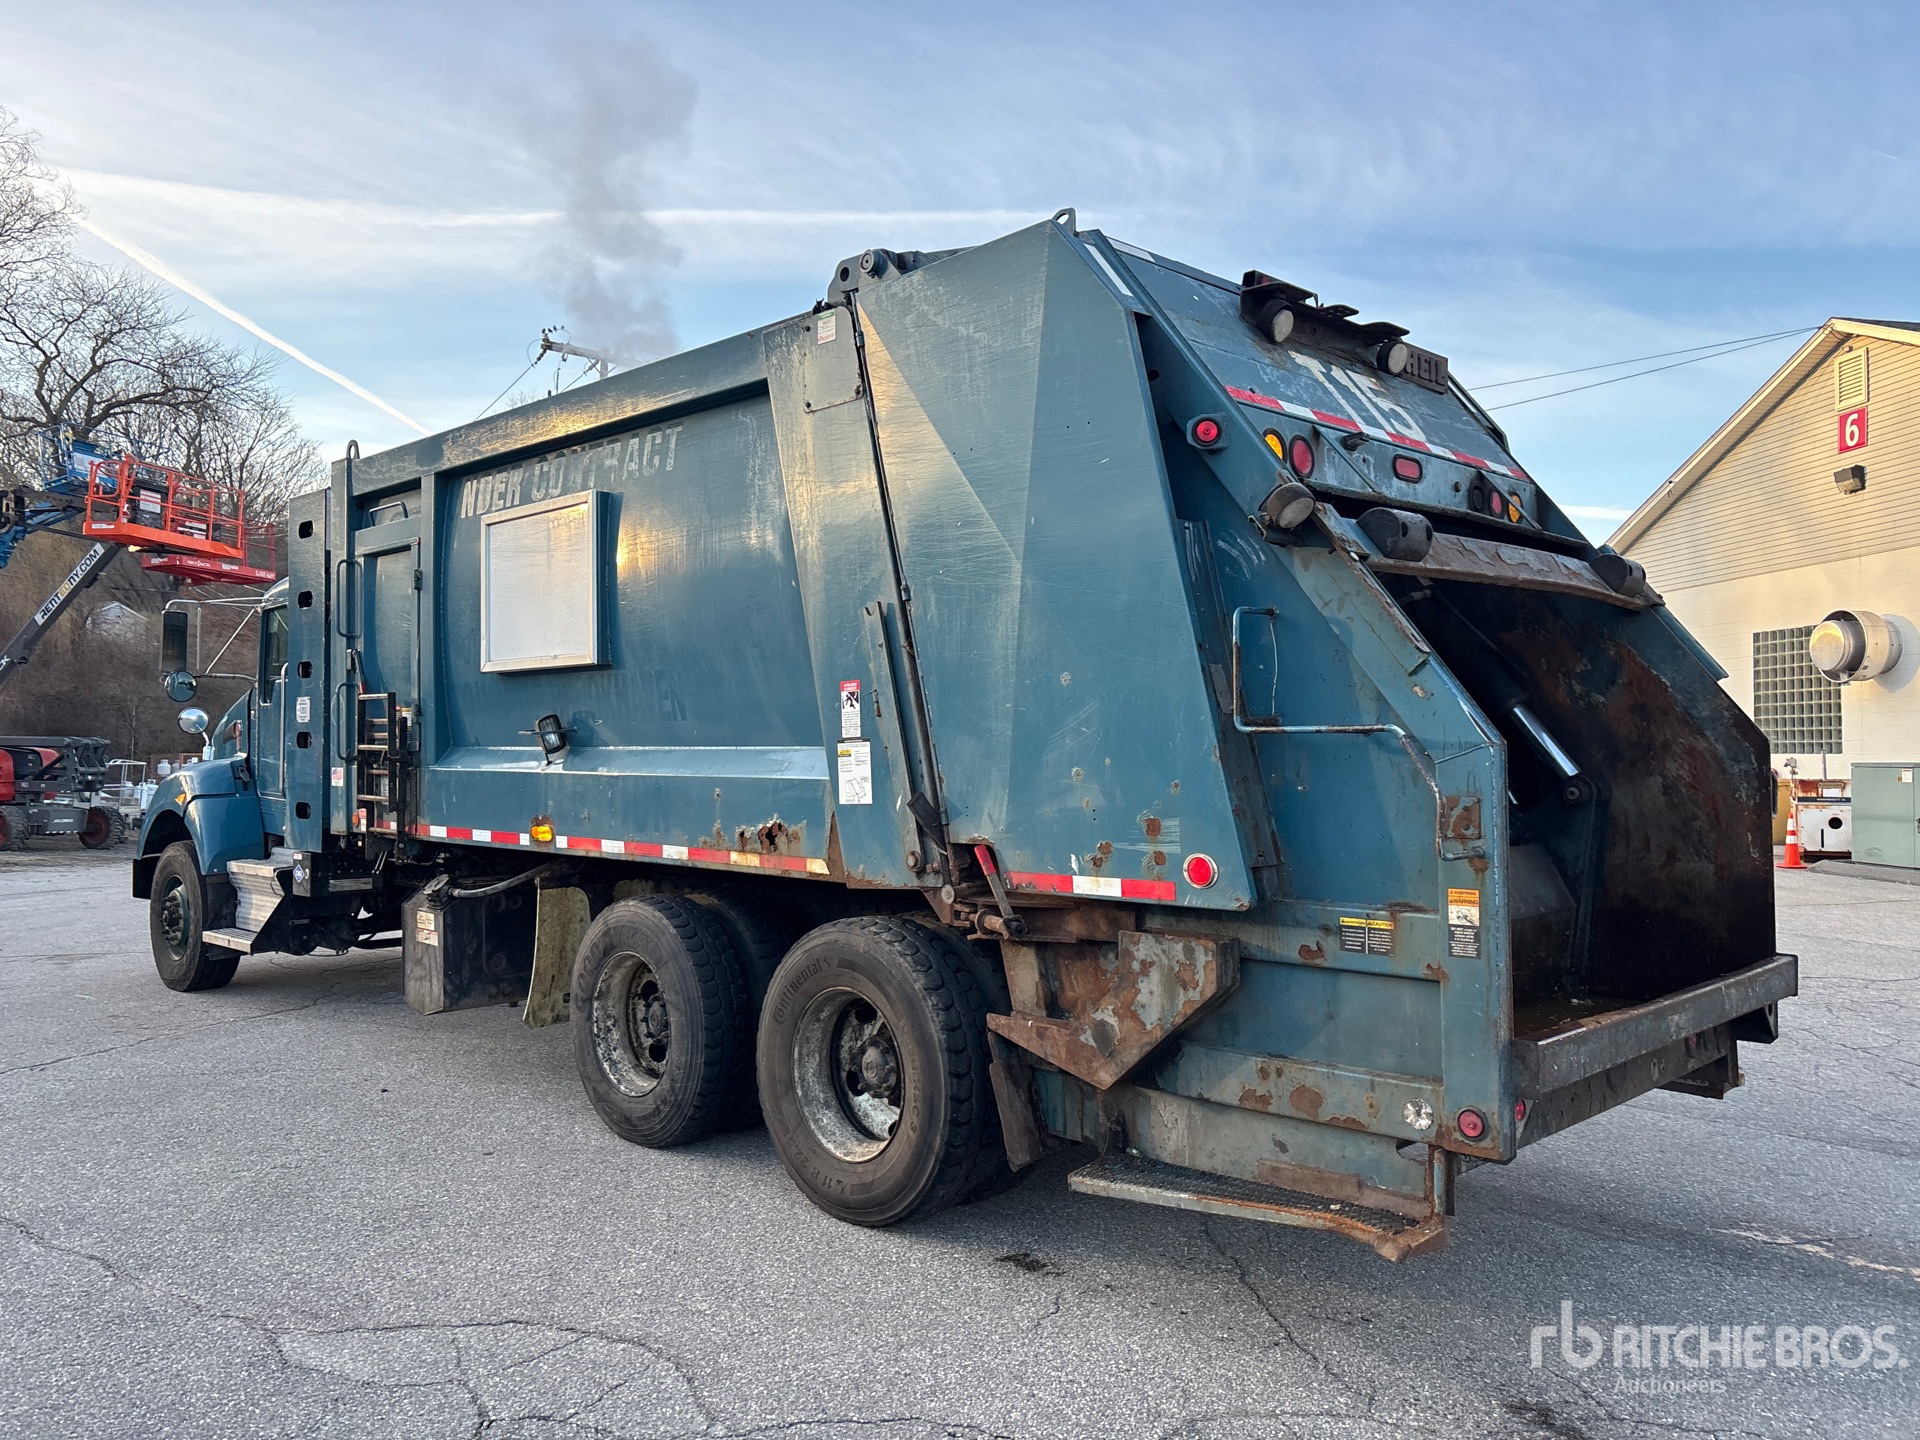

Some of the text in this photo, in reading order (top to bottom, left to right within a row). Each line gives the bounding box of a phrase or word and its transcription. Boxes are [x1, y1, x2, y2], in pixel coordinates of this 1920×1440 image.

[1845, 413, 1860, 447] 6
[187, 559, 211, 568] SKYJACK
[773, 958, 823, 1025] Continental
